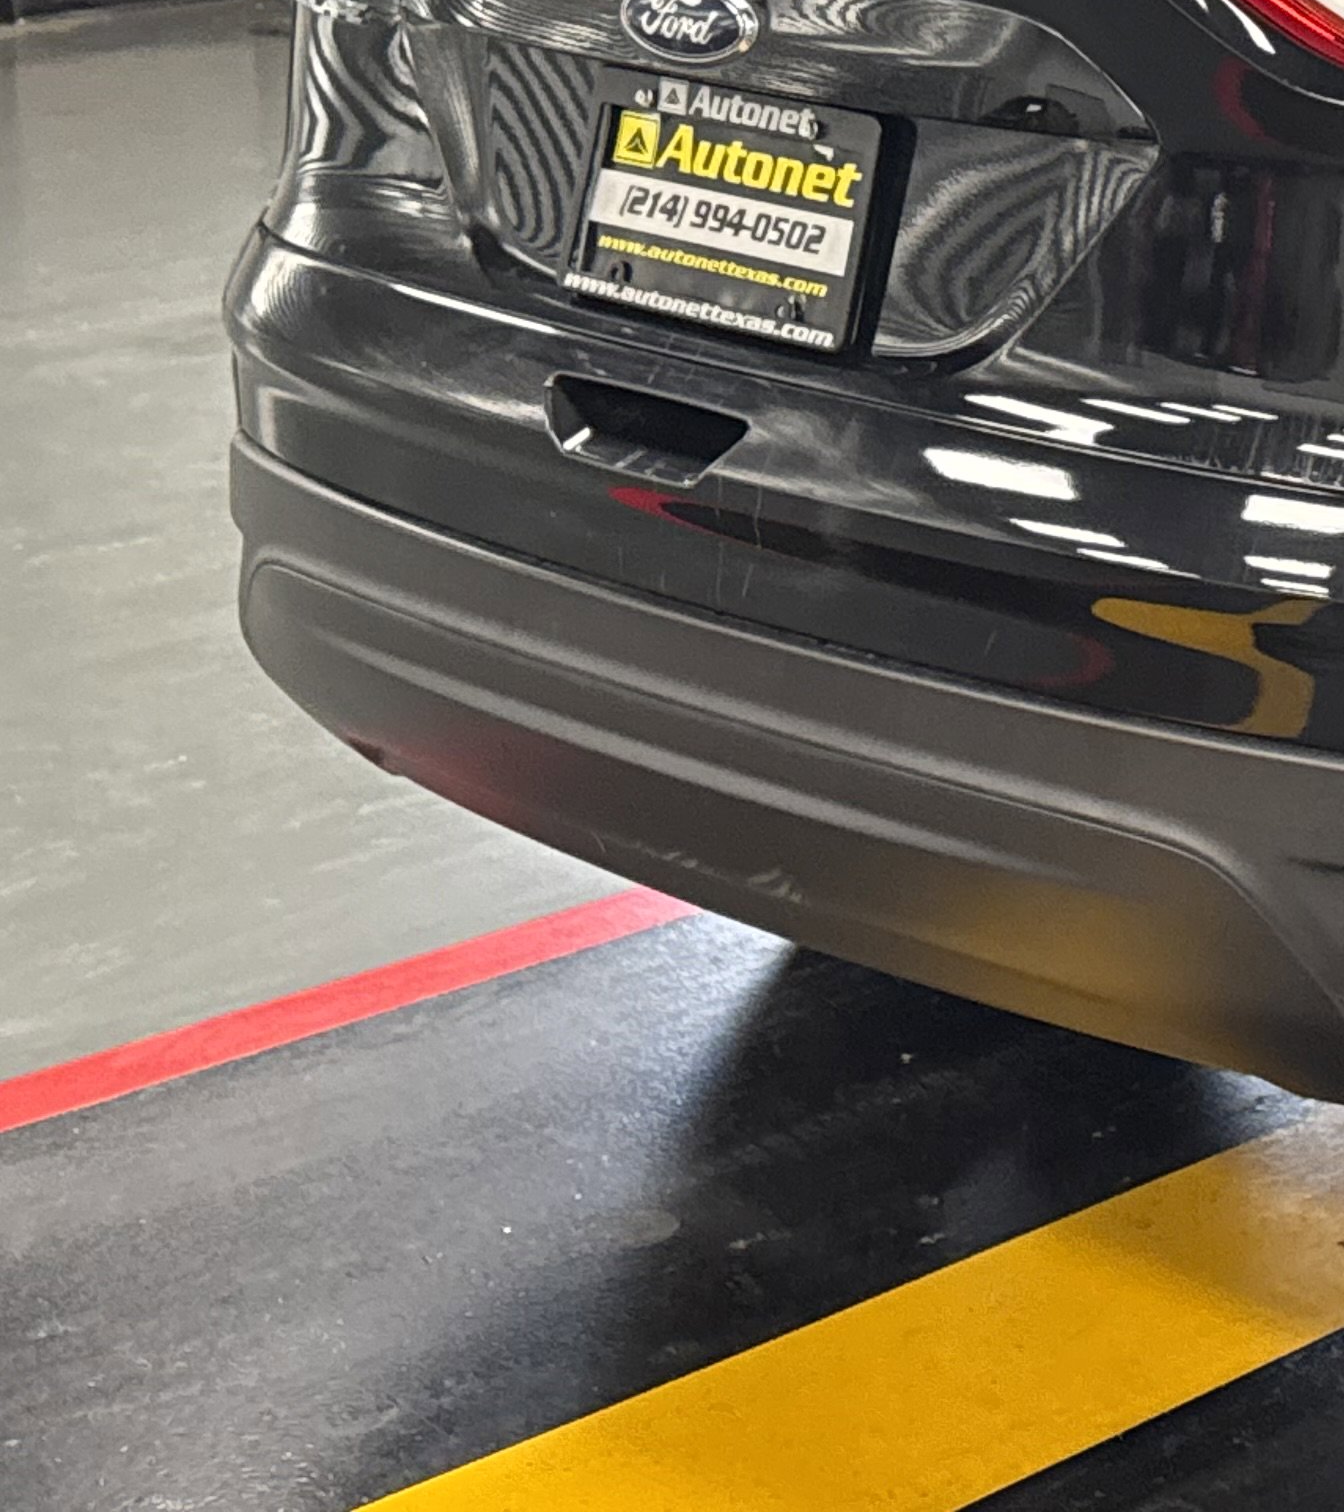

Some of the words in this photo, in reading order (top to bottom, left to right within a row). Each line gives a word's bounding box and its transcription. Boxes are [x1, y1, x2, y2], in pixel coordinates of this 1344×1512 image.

[689, 86, 815, 138] Autonet
[654, 124, 863, 207] Autonet
[620, 185, 689, 228] (214)
[691, 200, 827, 254] 994-0502
[597, 234, 828, 297] www.autonettexas.com
[563, 273, 834, 347] www.autonettexas.com
